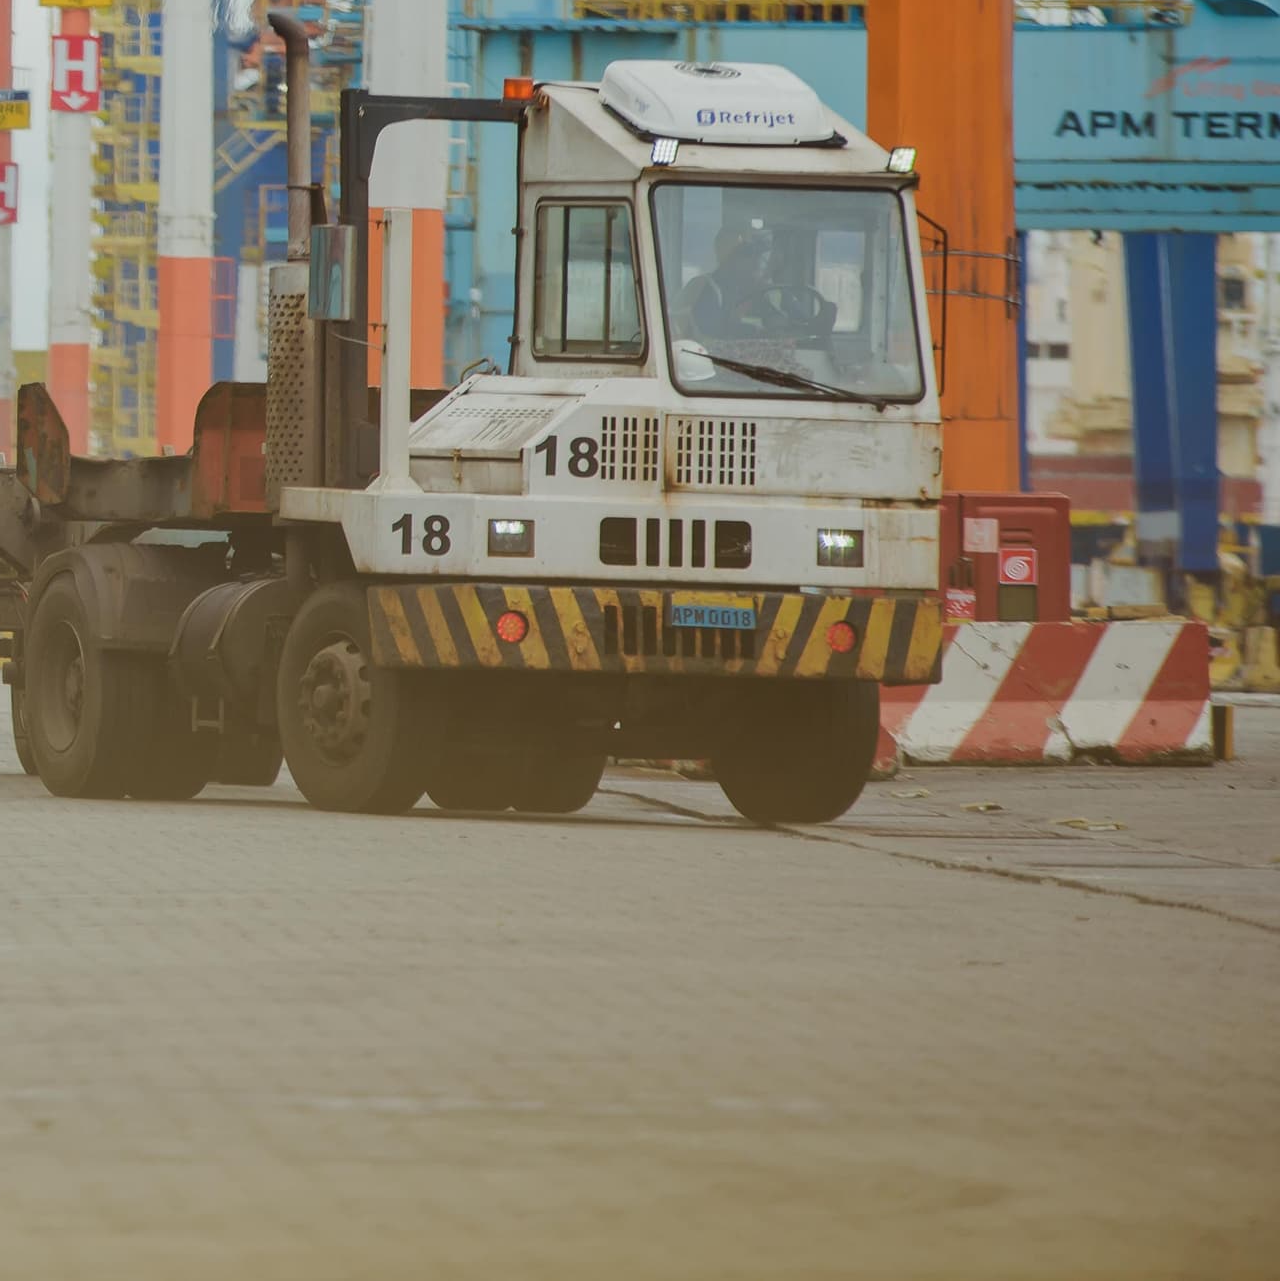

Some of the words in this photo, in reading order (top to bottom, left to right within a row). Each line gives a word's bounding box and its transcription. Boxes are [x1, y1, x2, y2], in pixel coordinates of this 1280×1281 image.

[53, 39, 98, 92] H
[719, 111, 796, 127] Refrijet
[1054, 110, 1157, 138] APM
[533, 435, 599, 479] 18
[391, 513, 451, 556] 18
[672, 607, 752, 627] APM0018
